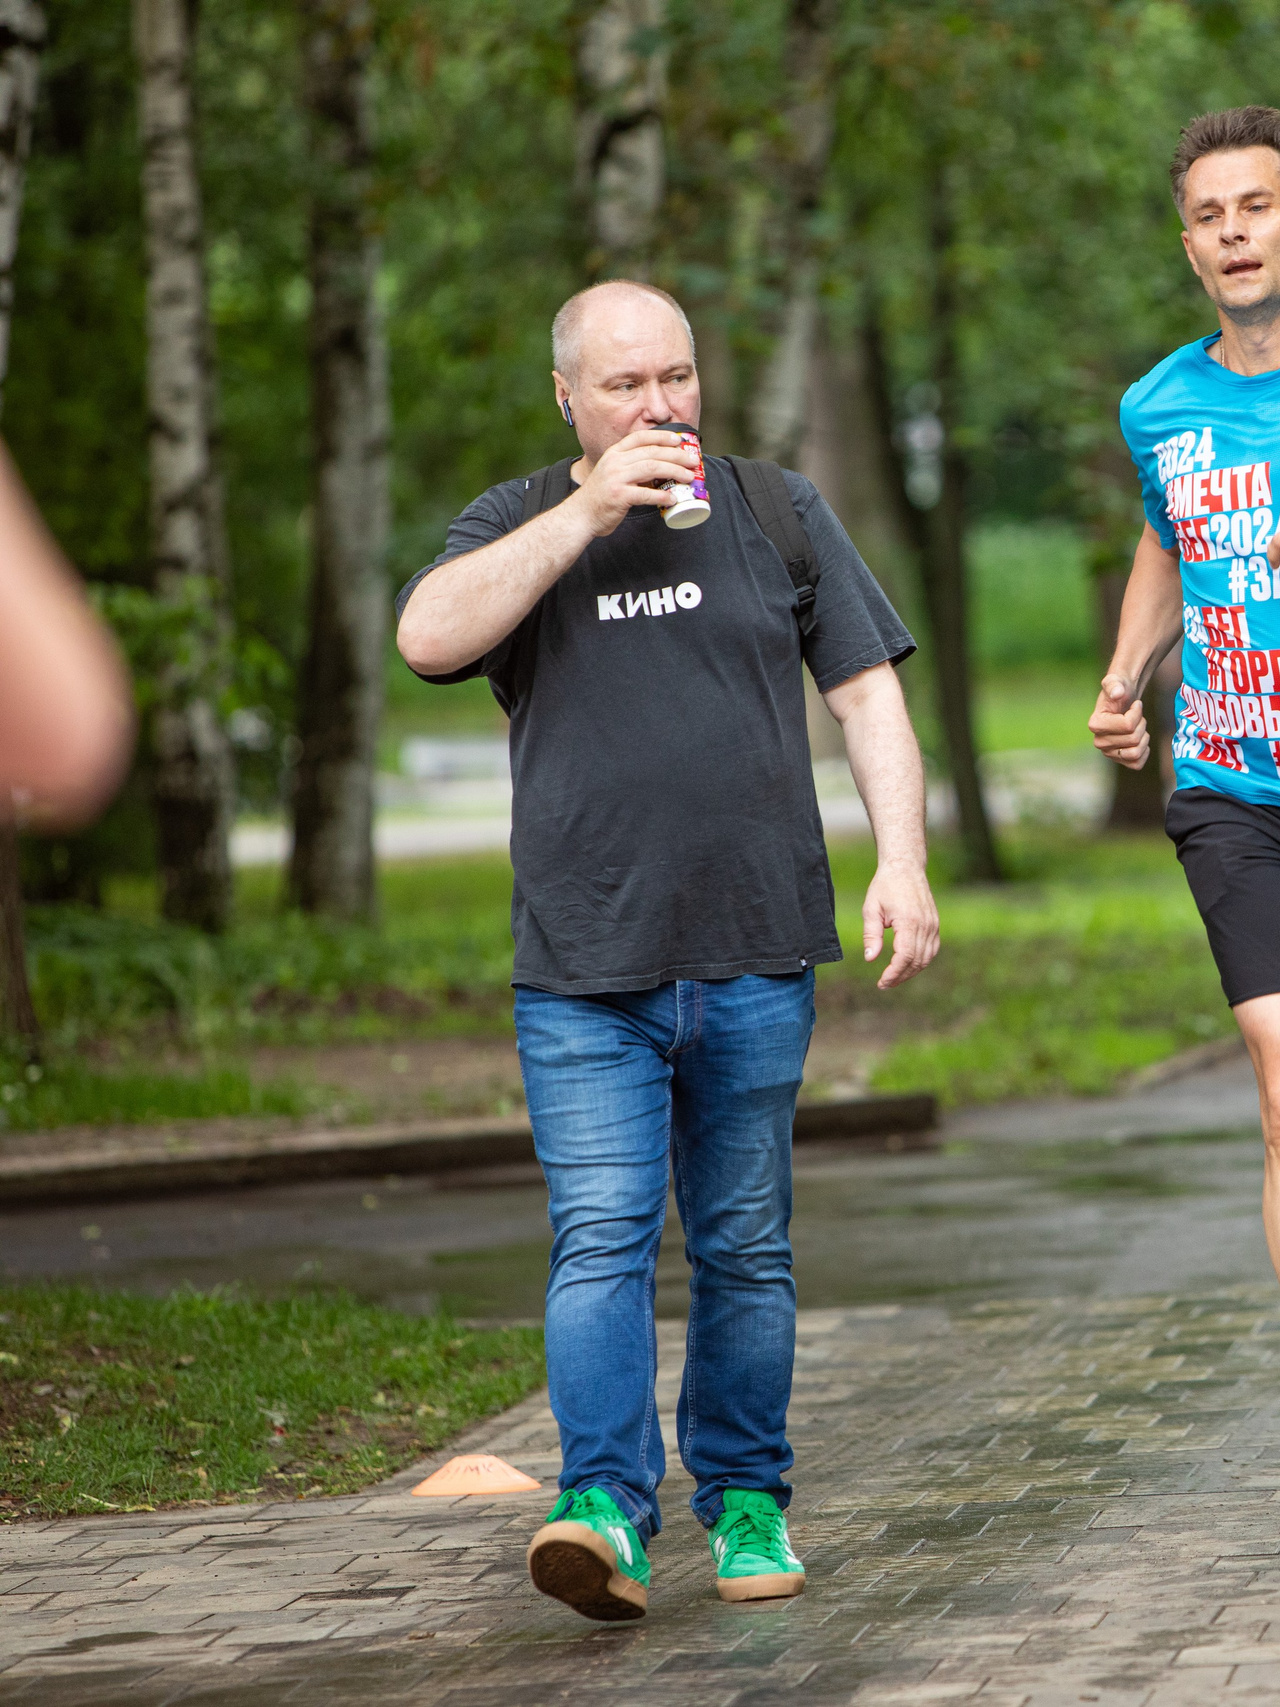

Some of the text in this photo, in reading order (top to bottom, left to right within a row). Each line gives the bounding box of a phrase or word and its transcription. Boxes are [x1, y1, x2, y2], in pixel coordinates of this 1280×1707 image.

[1152, 426, 1216, 485] 2024
[1165, 462, 1272, 521] #МЕЧТА
[597, 581, 702, 621] КИНО
